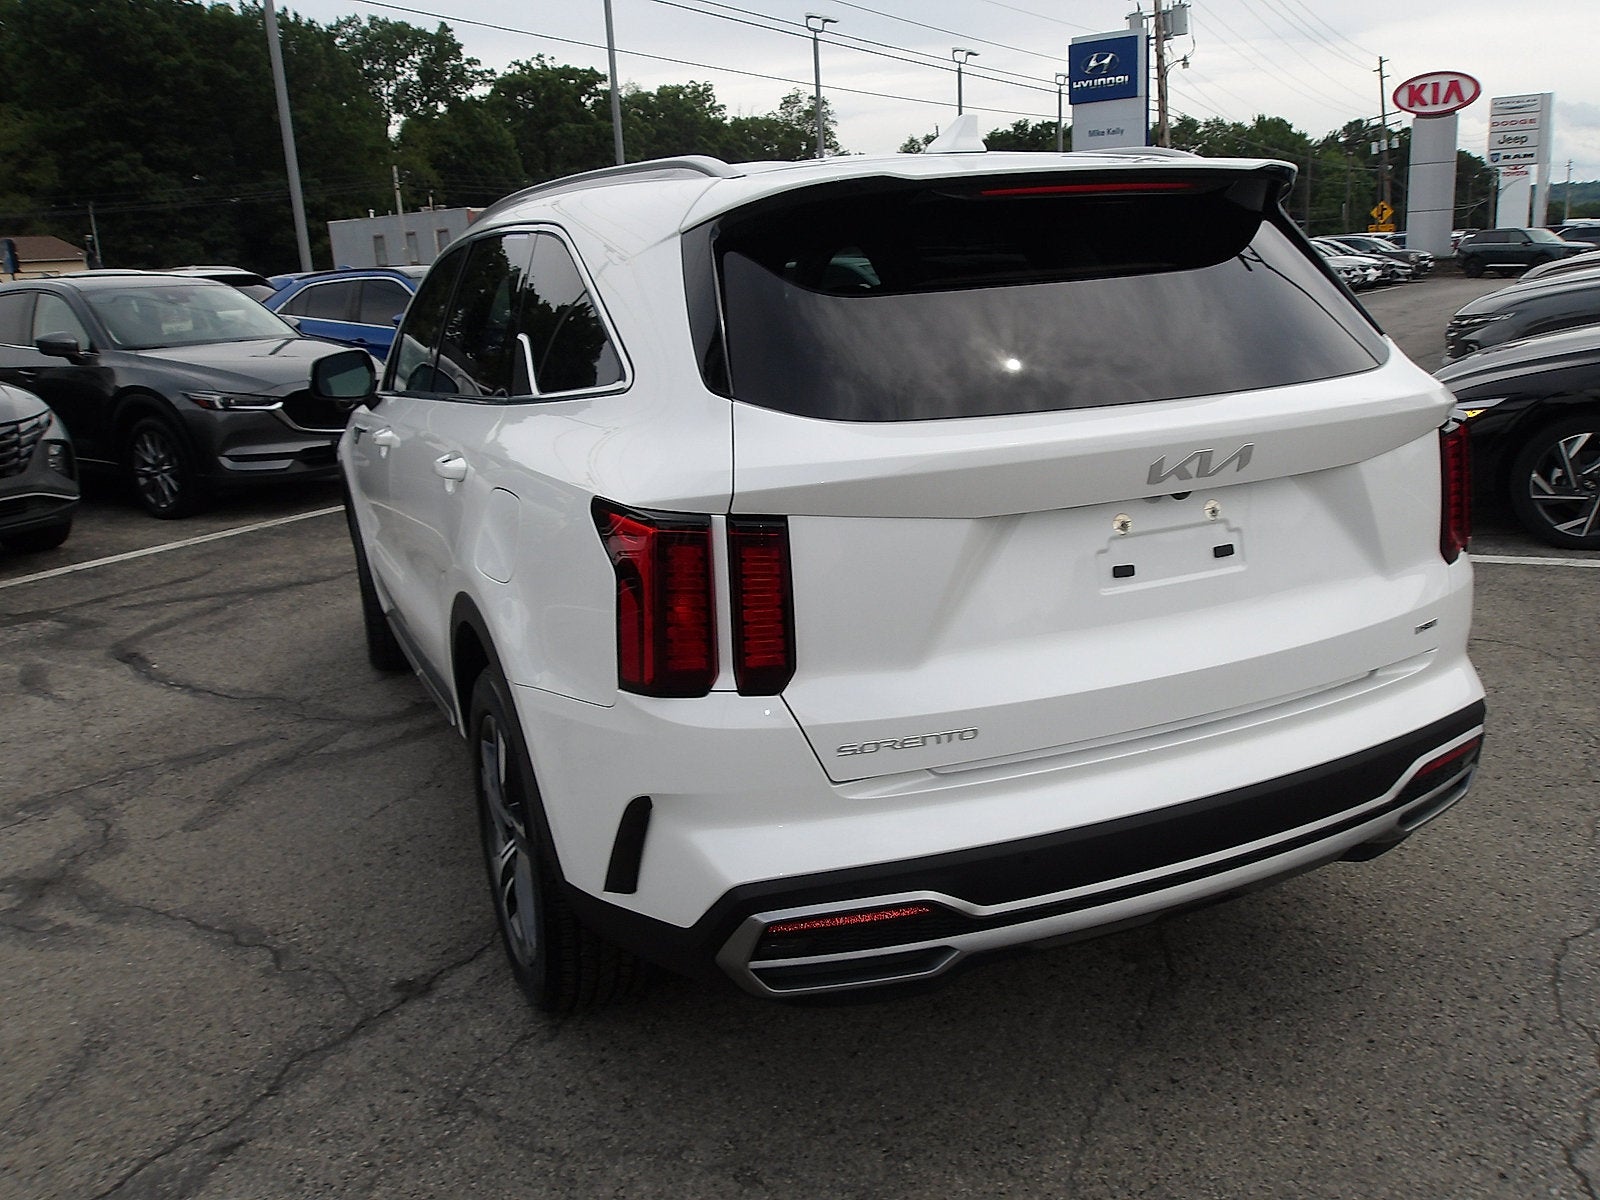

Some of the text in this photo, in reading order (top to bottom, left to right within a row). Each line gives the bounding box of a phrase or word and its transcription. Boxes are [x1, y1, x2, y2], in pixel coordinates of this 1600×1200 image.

[1072, 75, 1129, 89] HYUNDAI
[1407, 79, 1465, 108] KIA
[1491, 118, 1537, 127] DODGE
[1497, 134, 1528, 145] Jeep
[1502, 152, 1535, 160] RAM
[1147, 442, 1254, 485] KIA
[836, 726, 978, 757] SORENTO
